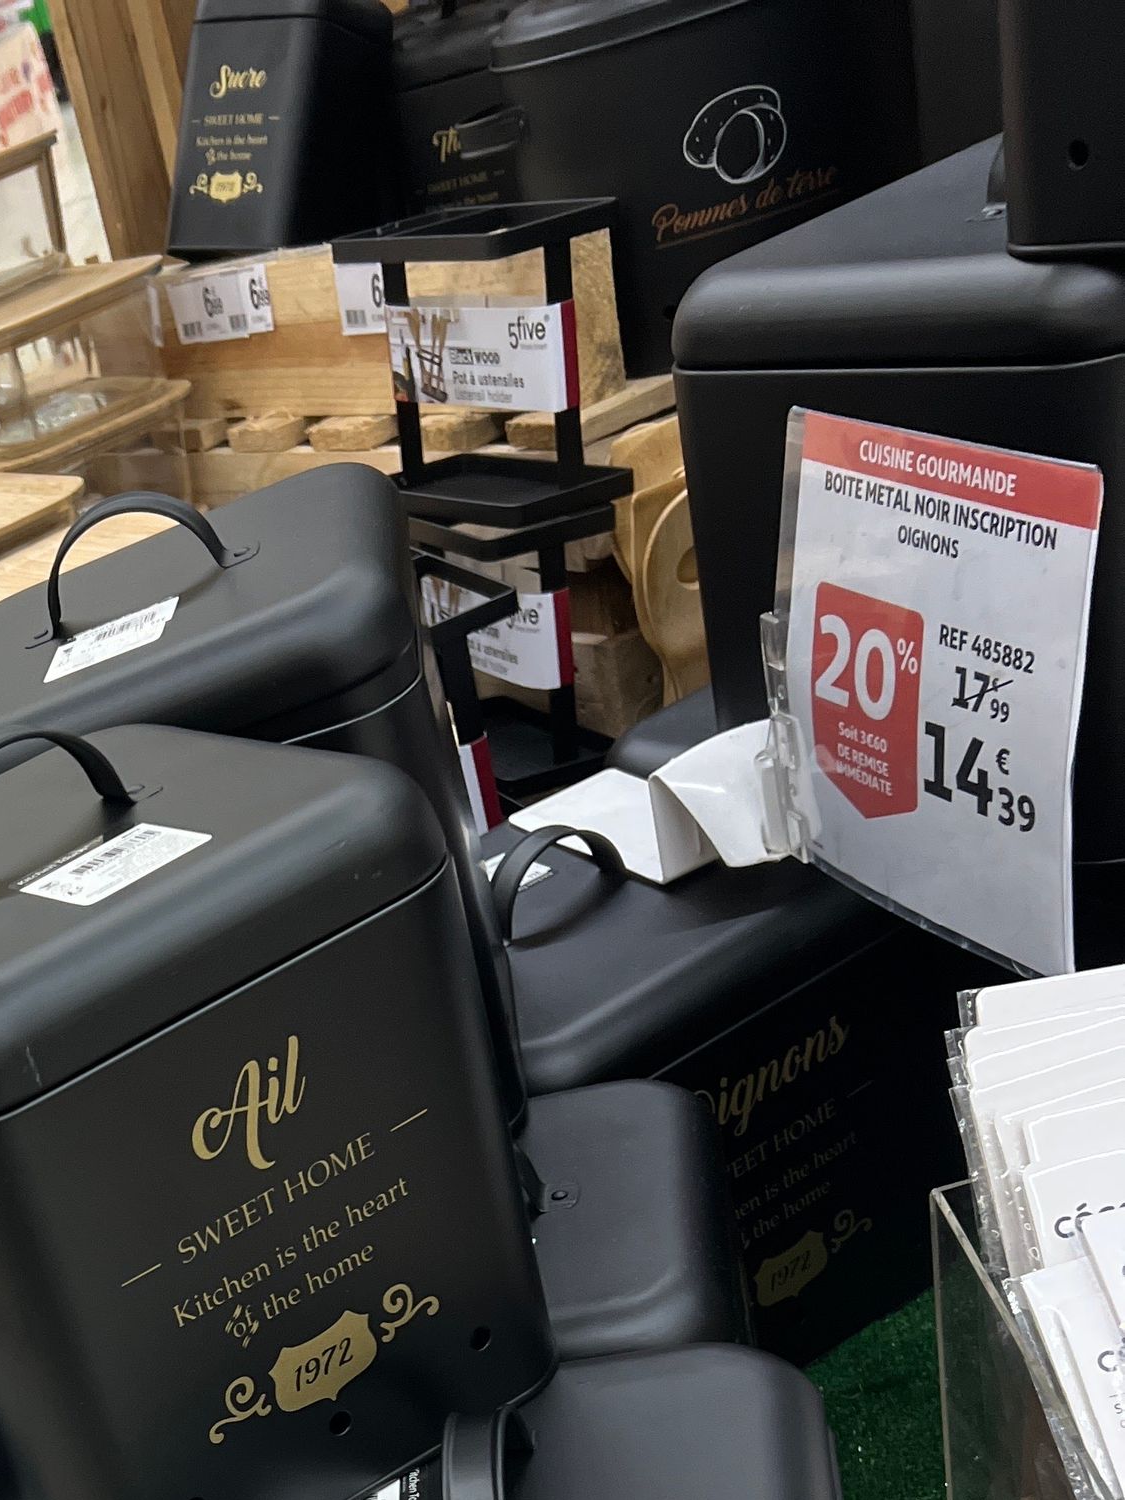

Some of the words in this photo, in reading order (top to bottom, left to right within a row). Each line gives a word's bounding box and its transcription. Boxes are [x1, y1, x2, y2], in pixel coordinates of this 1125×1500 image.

[209, 65, 267, 98] Sucre
[432, 125, 461, 163] Th
[651, 194, 748, 243] Pommes
[755, 179, 782, 210] de
[507, 316, 546, 350] 5five
[453, 370, 468, 385] Pot
[479, 369, 525, 389] ustensiles
[859, 439, 913, 473] CUISINE
[917, 453, 1018, 497] GOURMANDE
[825, 469, 863, 500] BOITE
[865, 482, 911, 513] METAL
[914, 494, 950, 524] NOIR
[954, 506, 1057, 550] INSCRIPTION
[897, 524, 959, 559] OIGNONS
[814, 614, 918, 721] 20%
[939, 624, 968, 652] REF
[971, 635, 1035, 674] 485882
[837, 743, 852, 762] DE
[851, 747, 890, 777] REMISE
[838, 721, 858, 743] Soit
[860, 729, 888, 754] 3€60
[835, 760, 893, 797] IMMÉDIATE
[191, 1034, 306, 1171] Ail
[697, 1015, 850, 1137] ignons
[728, 1144, 768, 1179] EET
[775, 1101, 836, 1153] HOME
[783, 1162, 810, 1190] the
[812, 1130, 859, 1169] heart
[177, 1187, 276, 1265] SWEET
[282, 1132, 376, 1204] HOME
[753, 1213, 780, 1241] the
[783, 1179, 832, 1221] home
[172, 1261, 271, 1328] Kitchen
[275, 1247, 297, 1270] is
[300, 1218, 340, 1254] the
[345, 1177, 409, 1228] heart
[262, 1287, 301, 1320] the
[305, 1244, 375, 1296] home
[292, 1337, 354, 1393] 1972
[409, 1468, 421, 1493] itchen
